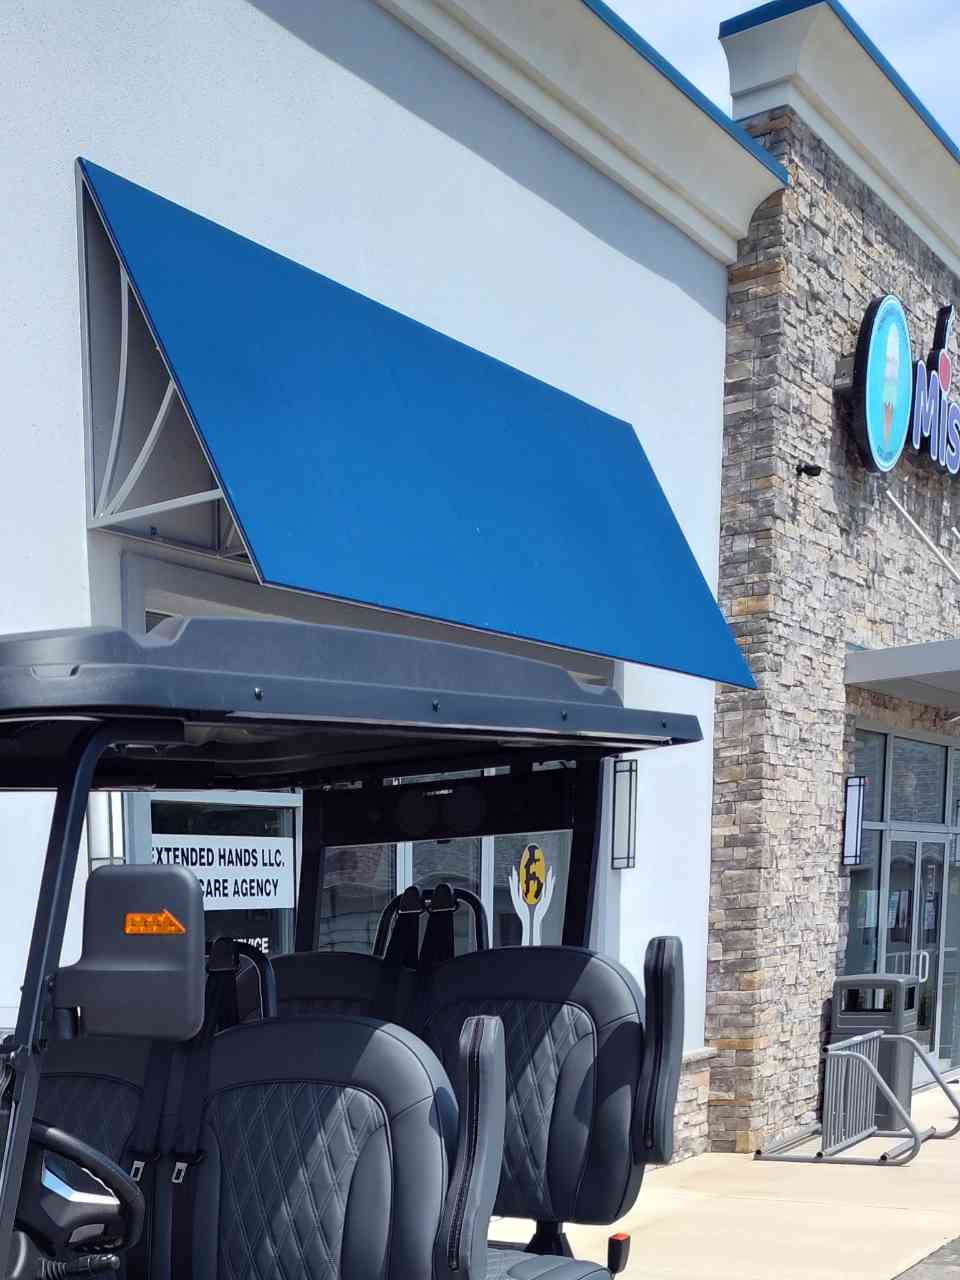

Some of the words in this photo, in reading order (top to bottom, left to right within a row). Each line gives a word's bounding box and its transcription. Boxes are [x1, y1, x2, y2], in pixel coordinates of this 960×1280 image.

[218, 848, 258, 867] HANDS
[261, 849, 285, 867] LLC.
[232, 878, 279, 897] AGENCY
